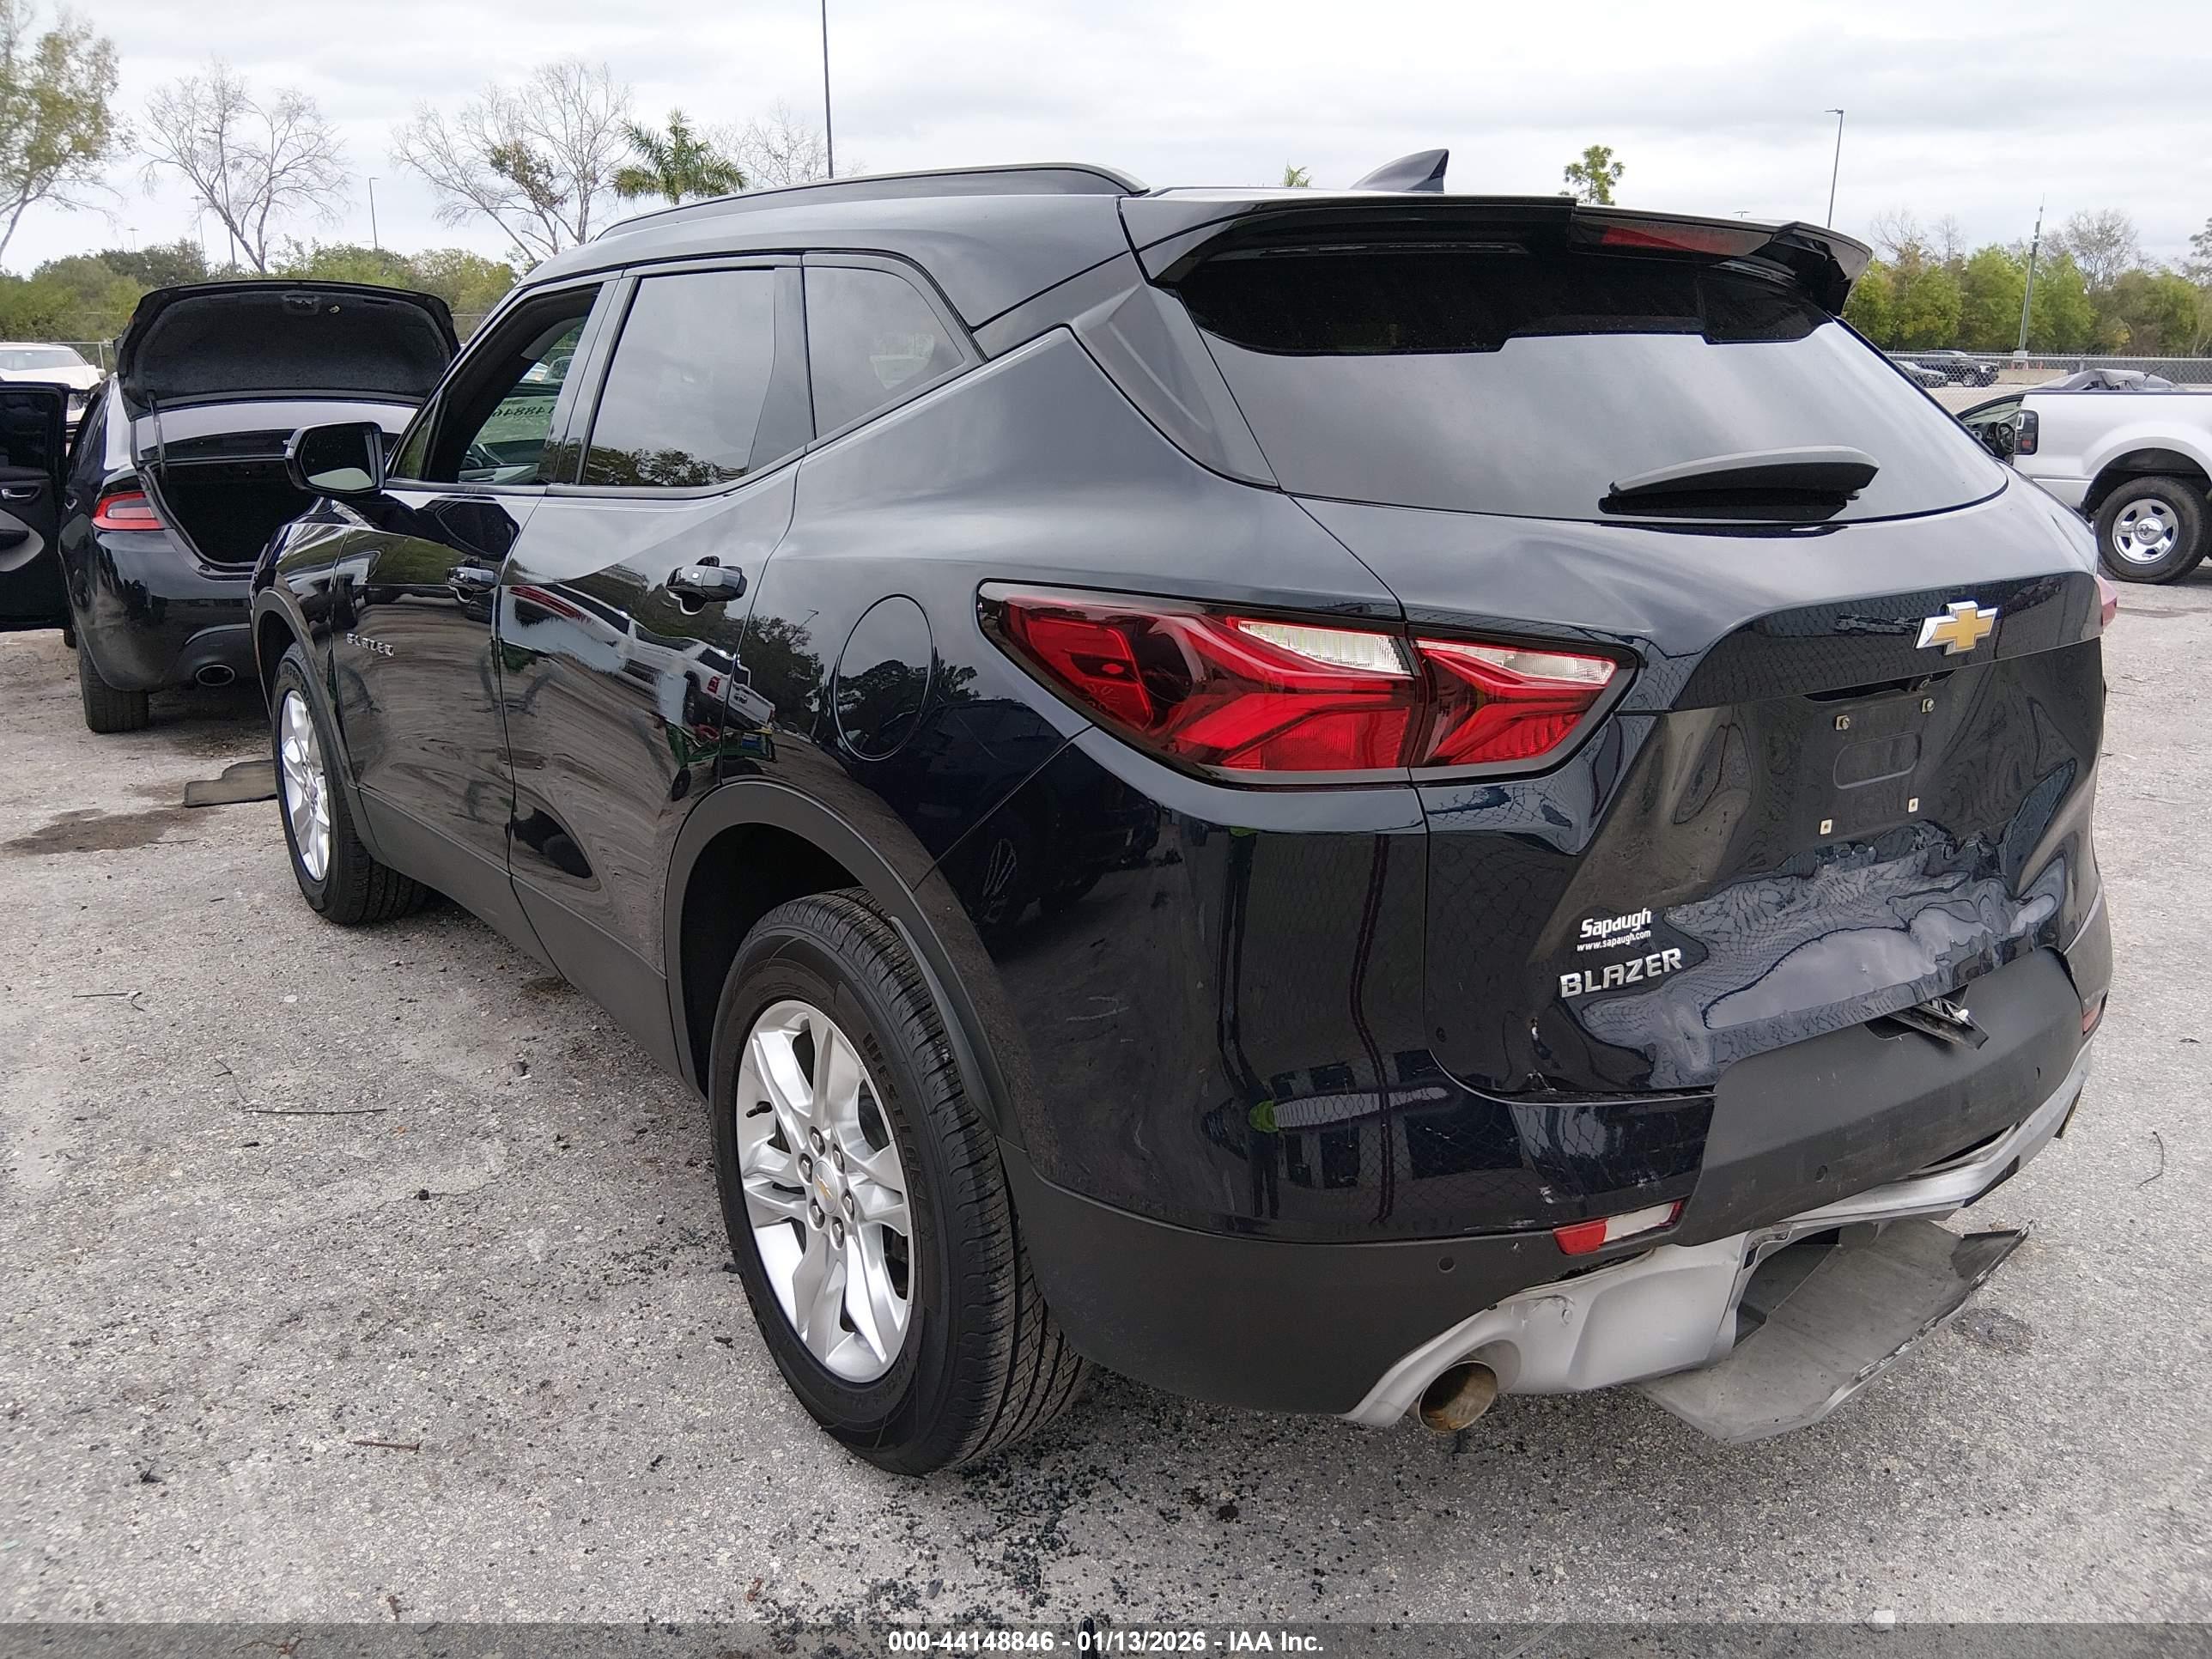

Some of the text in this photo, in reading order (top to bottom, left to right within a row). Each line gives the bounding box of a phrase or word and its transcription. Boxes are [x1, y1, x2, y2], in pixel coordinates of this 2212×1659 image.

[1579, 908, 1652, 938] Sapaugh
[1577, 930, 1651, 952] www.sapaugh.com
[1559, 948, 1683, 998] BLAZER
